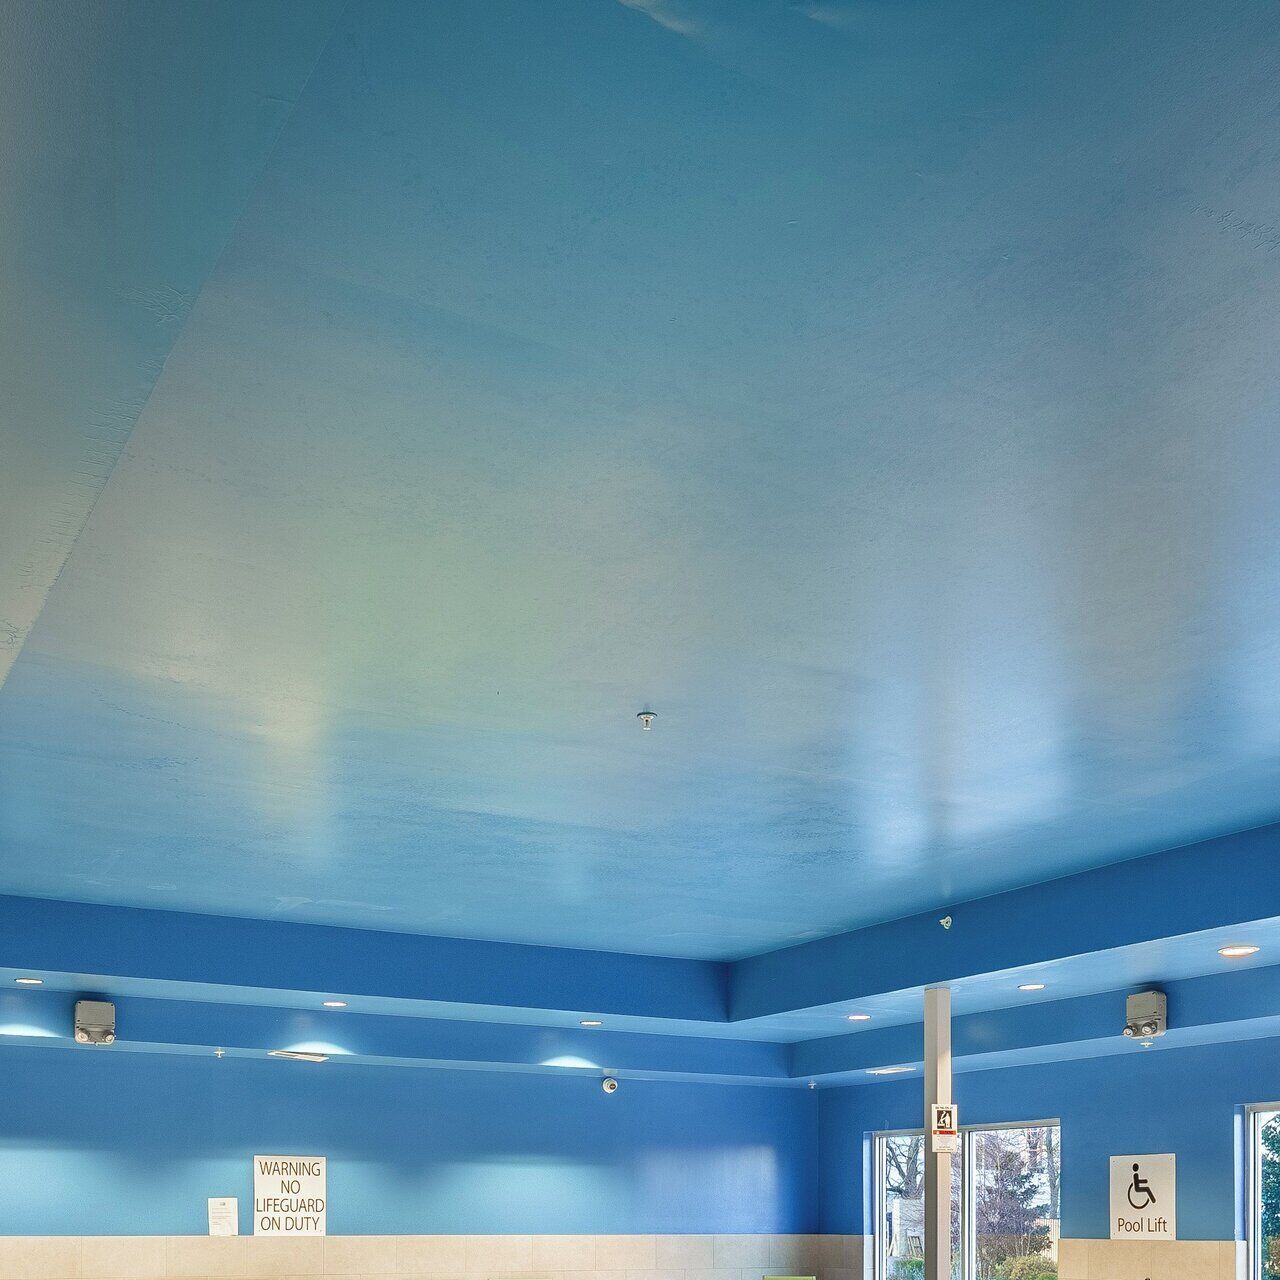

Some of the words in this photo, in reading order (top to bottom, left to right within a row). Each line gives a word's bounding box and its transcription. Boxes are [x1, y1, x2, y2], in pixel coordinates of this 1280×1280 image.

[258, 1160, 321, 1177] WARNING
[280, 1179, 301, 1195] NO
[256, 1198, 325, 1213] LIFEGUARD
[260, 1216, 281, 1231] ON
[284, 1216, 320, 1231] DUTY
[1117, 1217, 1144, 1233] Pool
[1147, 1217, 1168, 1233] Lift
